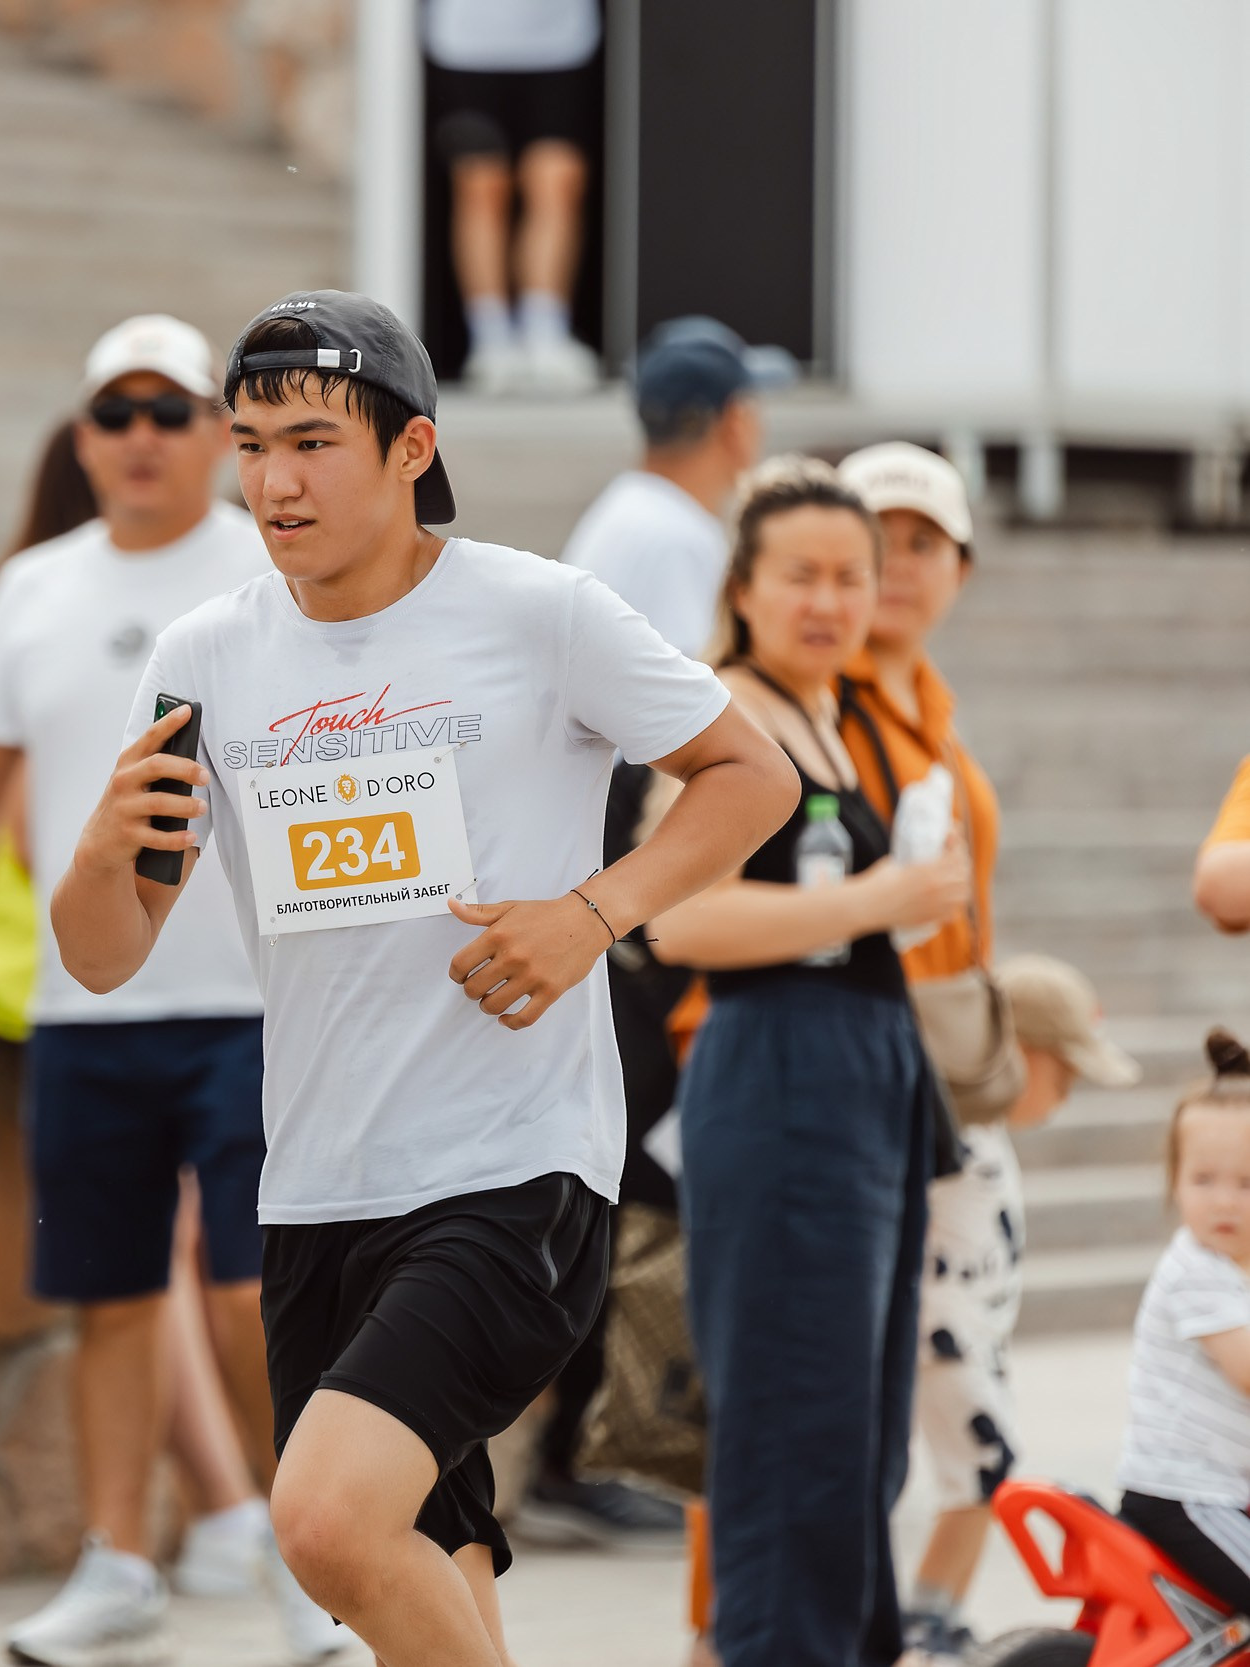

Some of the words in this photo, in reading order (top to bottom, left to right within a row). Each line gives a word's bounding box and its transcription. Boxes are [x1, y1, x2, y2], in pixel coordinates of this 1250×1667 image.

[223, 714, 482, 770] SENSITIVE
[268, 683, 453, 767] Touch
[257, 785, 329, 809] LEONE
[367, 772, 435, 797] D'ORO
[301, 821, 406, 881] 234
[276, 887, 411, 915] БЛАГОТВОРИТЕЛЬНЫЙ
[413, 883, 451, 899] ЗАБЕГ
